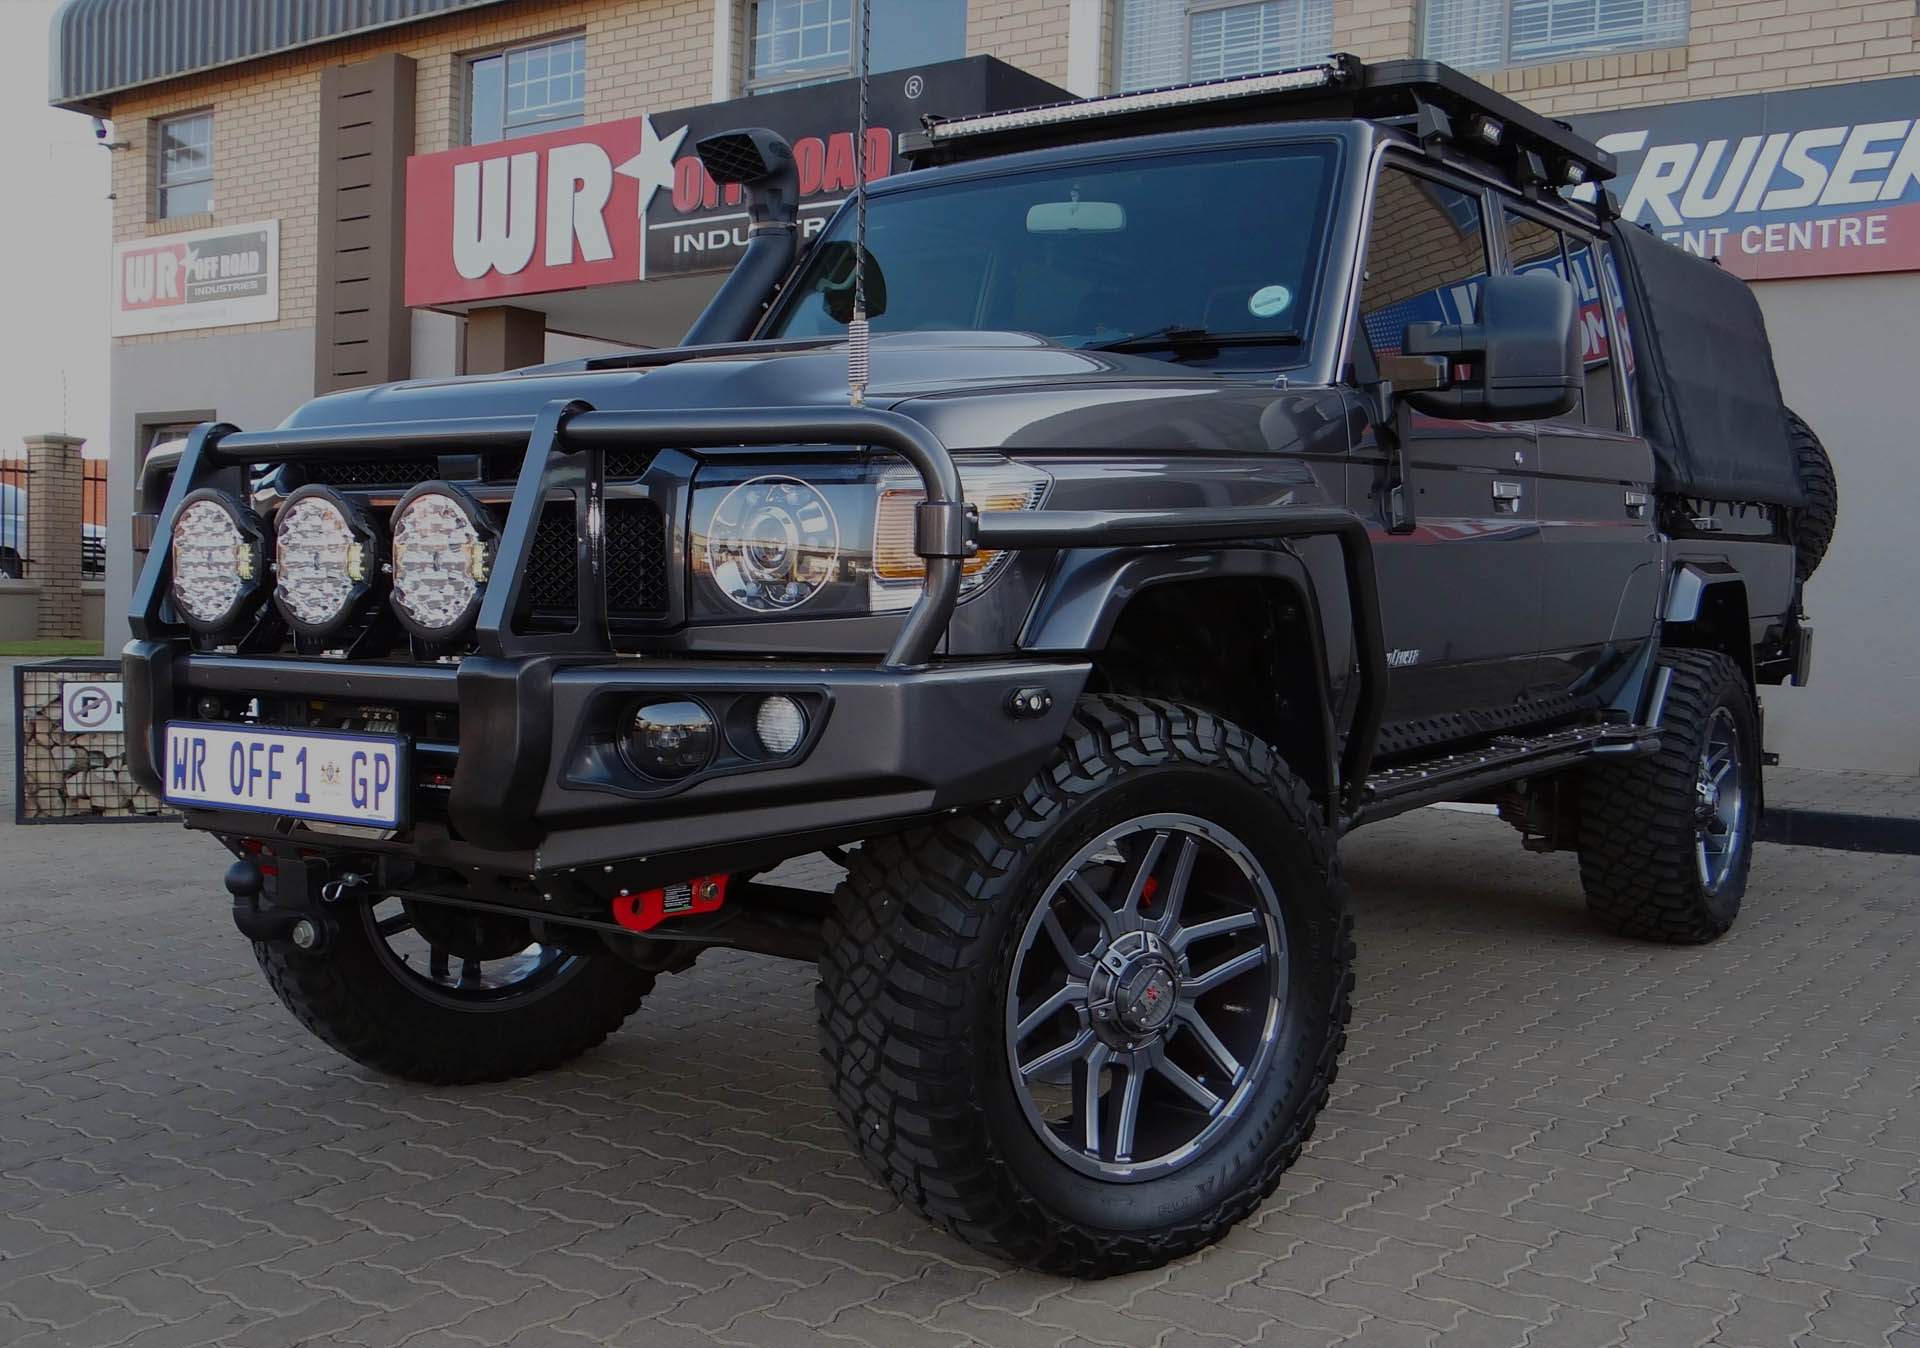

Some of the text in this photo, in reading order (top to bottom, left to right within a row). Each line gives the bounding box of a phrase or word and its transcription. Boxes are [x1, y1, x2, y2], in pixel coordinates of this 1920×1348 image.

[796, 127, 892, 196] OAD
[452, 142, 615, 280] WR
[1741, 215, 1887, 254] CENTRE
[125, 252, 179, 304] WR
[194, 280, 258, 297] INDUSTRIES
[195, 251, 259, 281] OFF ROAD
[173, 737, 206, 792] WR
[351, 752, 390, 810] GP
